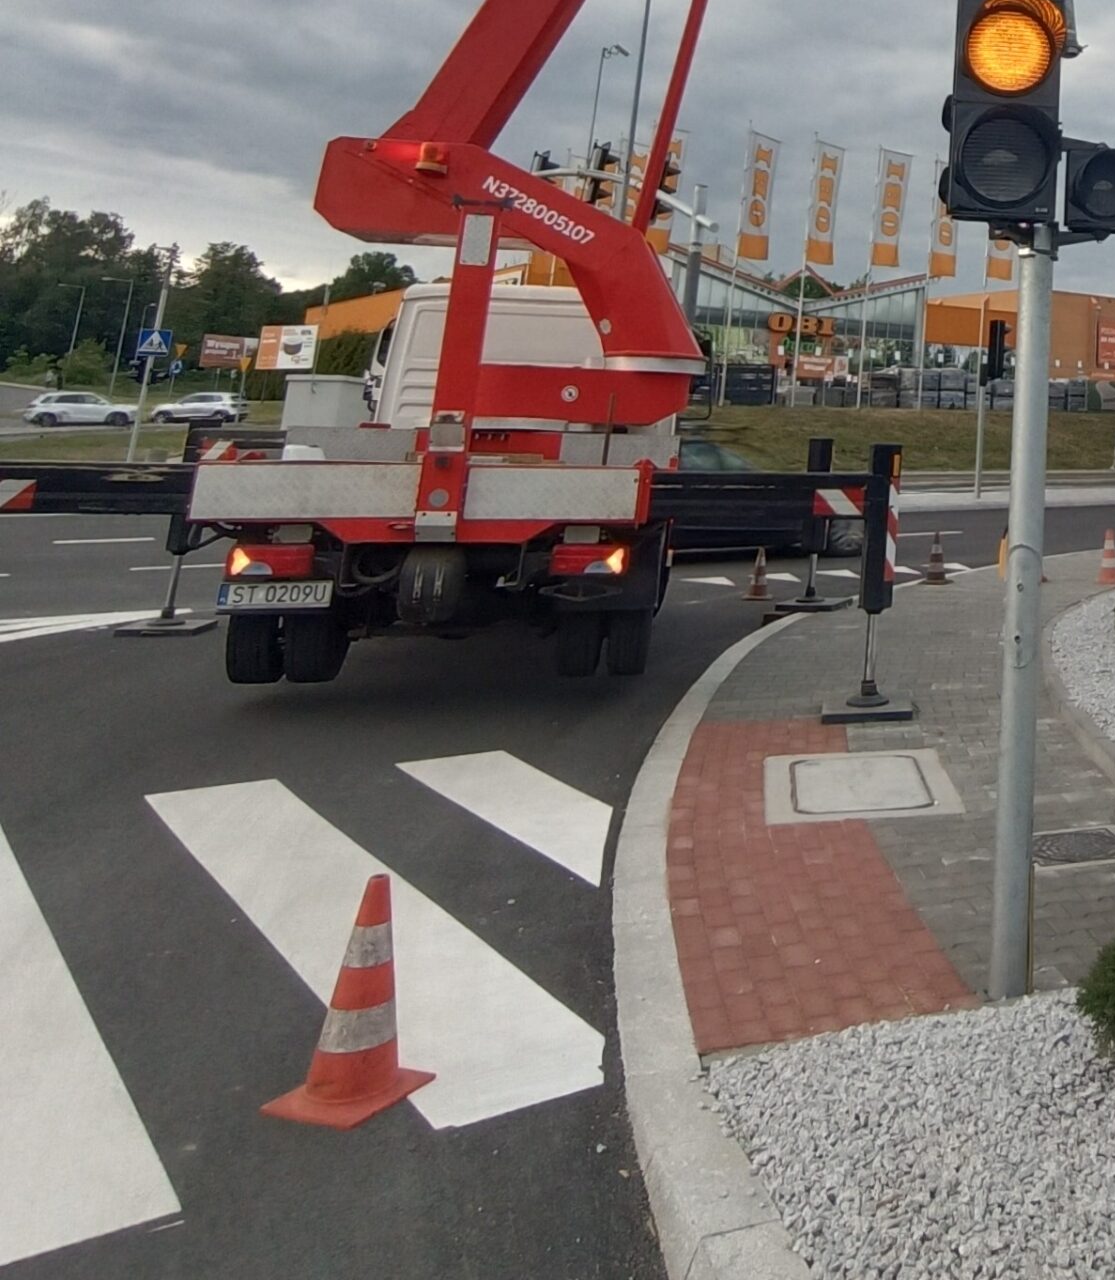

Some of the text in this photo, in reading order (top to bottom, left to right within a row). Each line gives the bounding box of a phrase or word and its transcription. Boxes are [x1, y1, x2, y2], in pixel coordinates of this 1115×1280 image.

[750, 144, 773, 227] OBI
[815, 152, 838, 233] OBI
[880, 160, 905, 236] OBI
[768, 312, 834, 335] OBI
[233, 584, 327, 603] ST 0209U
